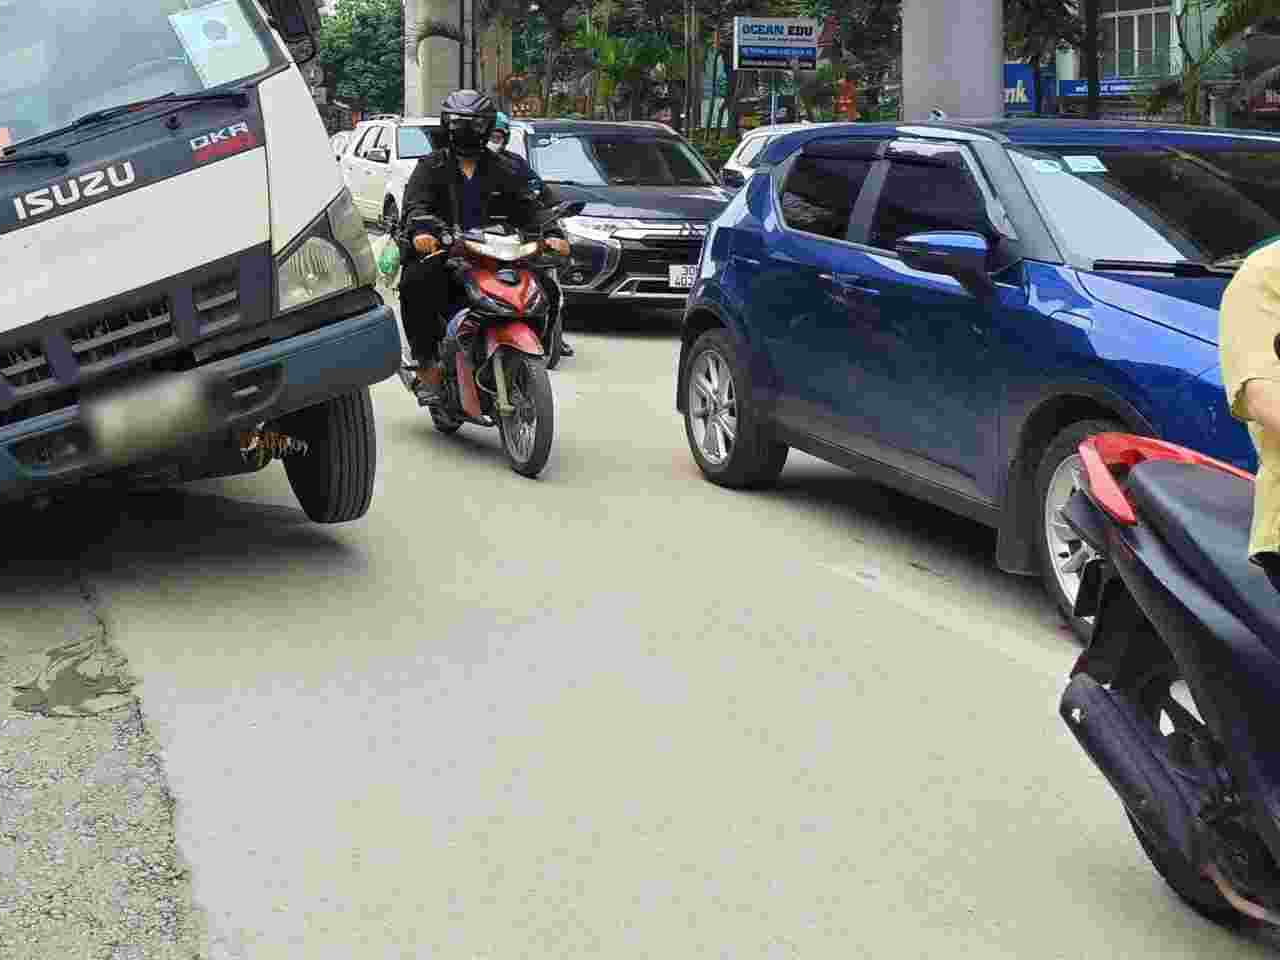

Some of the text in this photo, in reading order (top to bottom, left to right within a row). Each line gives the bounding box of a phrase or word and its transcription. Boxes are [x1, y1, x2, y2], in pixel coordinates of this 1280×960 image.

[742, 24, 814, 37] OCEAN EDU
[13, 160, 136, 220] ISUZU
